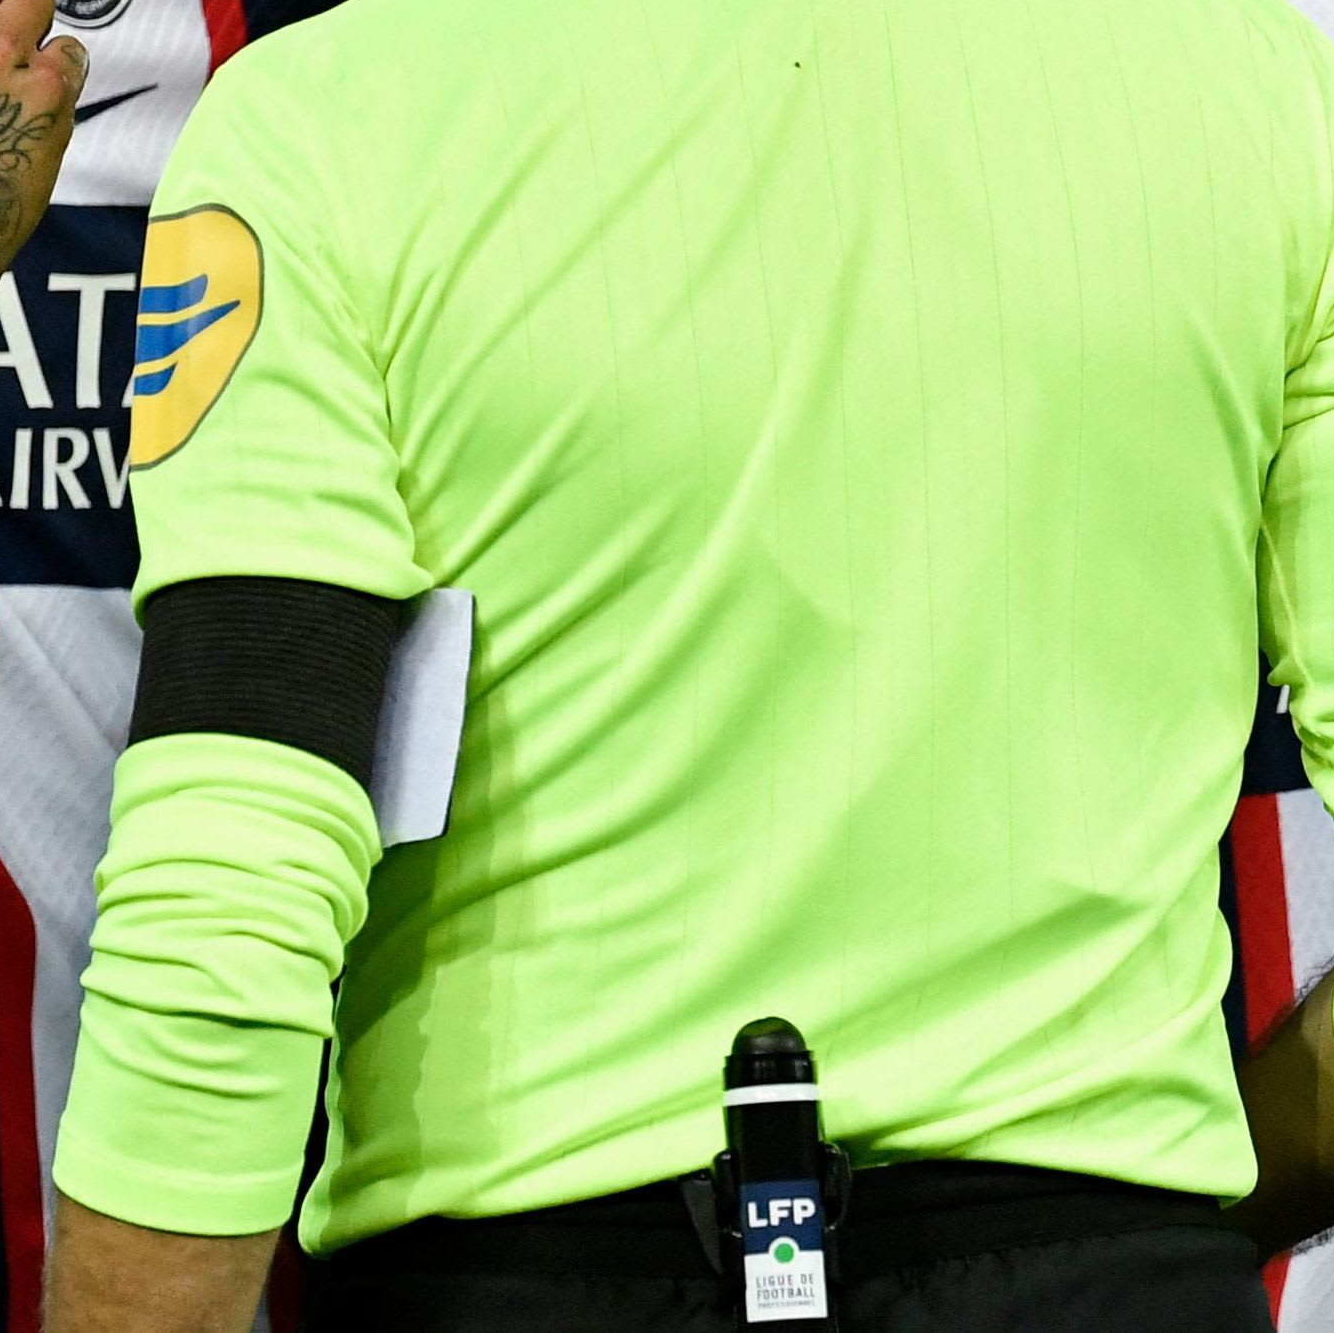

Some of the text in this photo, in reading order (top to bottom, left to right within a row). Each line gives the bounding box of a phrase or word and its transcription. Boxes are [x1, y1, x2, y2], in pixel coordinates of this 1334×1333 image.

[748, 1198, 816, 1228] LFP
[756, 1273, 814, 1288] LIGUE DE
[757, 1287, 815, 1300] FOOTBALL
